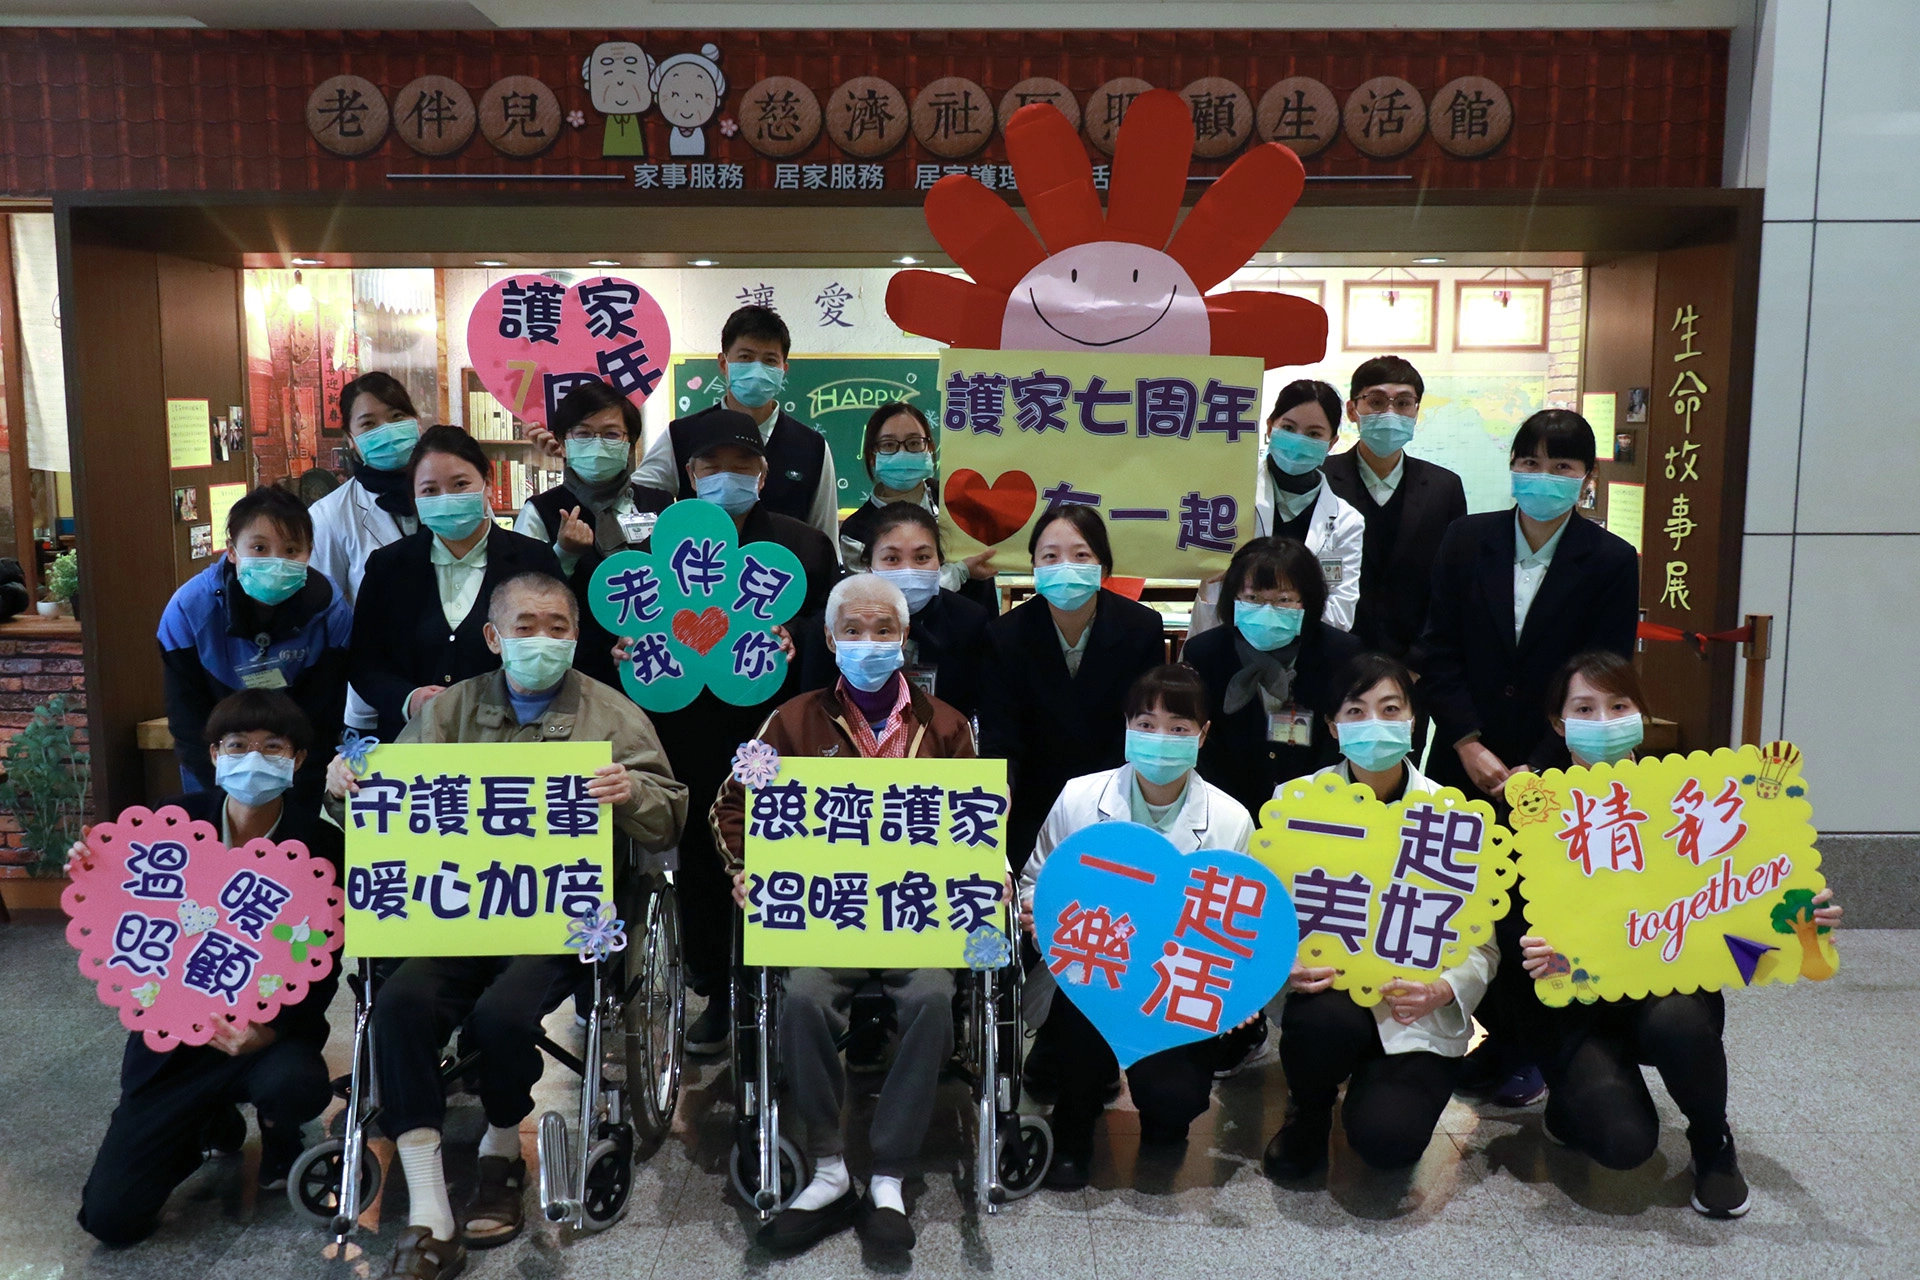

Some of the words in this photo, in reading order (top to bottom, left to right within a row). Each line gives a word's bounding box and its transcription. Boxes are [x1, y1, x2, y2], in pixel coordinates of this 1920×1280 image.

[318, 89, 546, 140] 老伴兒
[754, 89, 1495, 142] 慈濟社顧生活館
[633, 163, 744, 189] 家事服務
[774, 164, 885, 190] 居家服務
[498, 278, 640, 345] 護家
[817, 386, 904, 412] HAPPY
[943, 368, 1259, 444] 護家七周年
[1660, 304, 1710, 611] 生命故事展
[606, 537, 794, 625] 老伴兒
[631, 633, 684, 685] 我
[732, 631, 782, 681] 你
[349, 771, 601, 838] 守護長輩
[748, 778, 1008, 849] 慈濟護家
[1557, 778, 1749, 876] 精彩
[1286, 803, 1484, 894] 一起
[348, 857, 605, 921] 暖心加倍
[747, 870, 1006, 934] 溫暖像家
[1079, 853, 1268, 960] 一起
[1293, 867, 1466, 971] 美好
[1626, 854, 1792, 963] together
[109, 913, 261, 1004] 照顧
[1047, 899, 1235, 1034] 樂活
